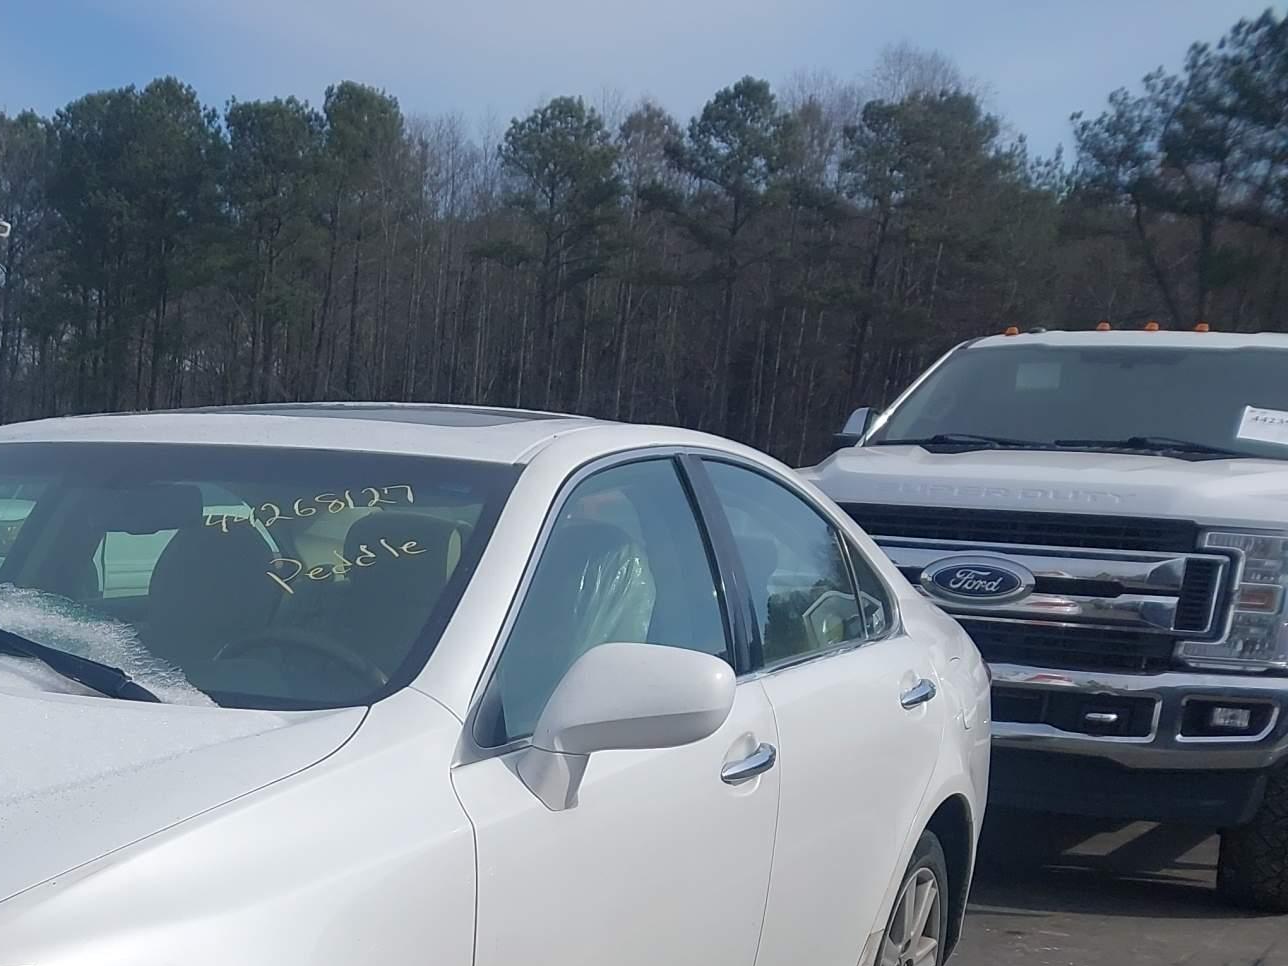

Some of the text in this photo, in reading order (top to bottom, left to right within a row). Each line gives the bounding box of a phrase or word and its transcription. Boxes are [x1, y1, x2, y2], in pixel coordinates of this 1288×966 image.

[205, 484, 414, 533] 44268127
[1017, 487, 1137, 504] DUTY
[266, 538, 427, 594] Peddle
[949, 568, 1004, 592] Ford
